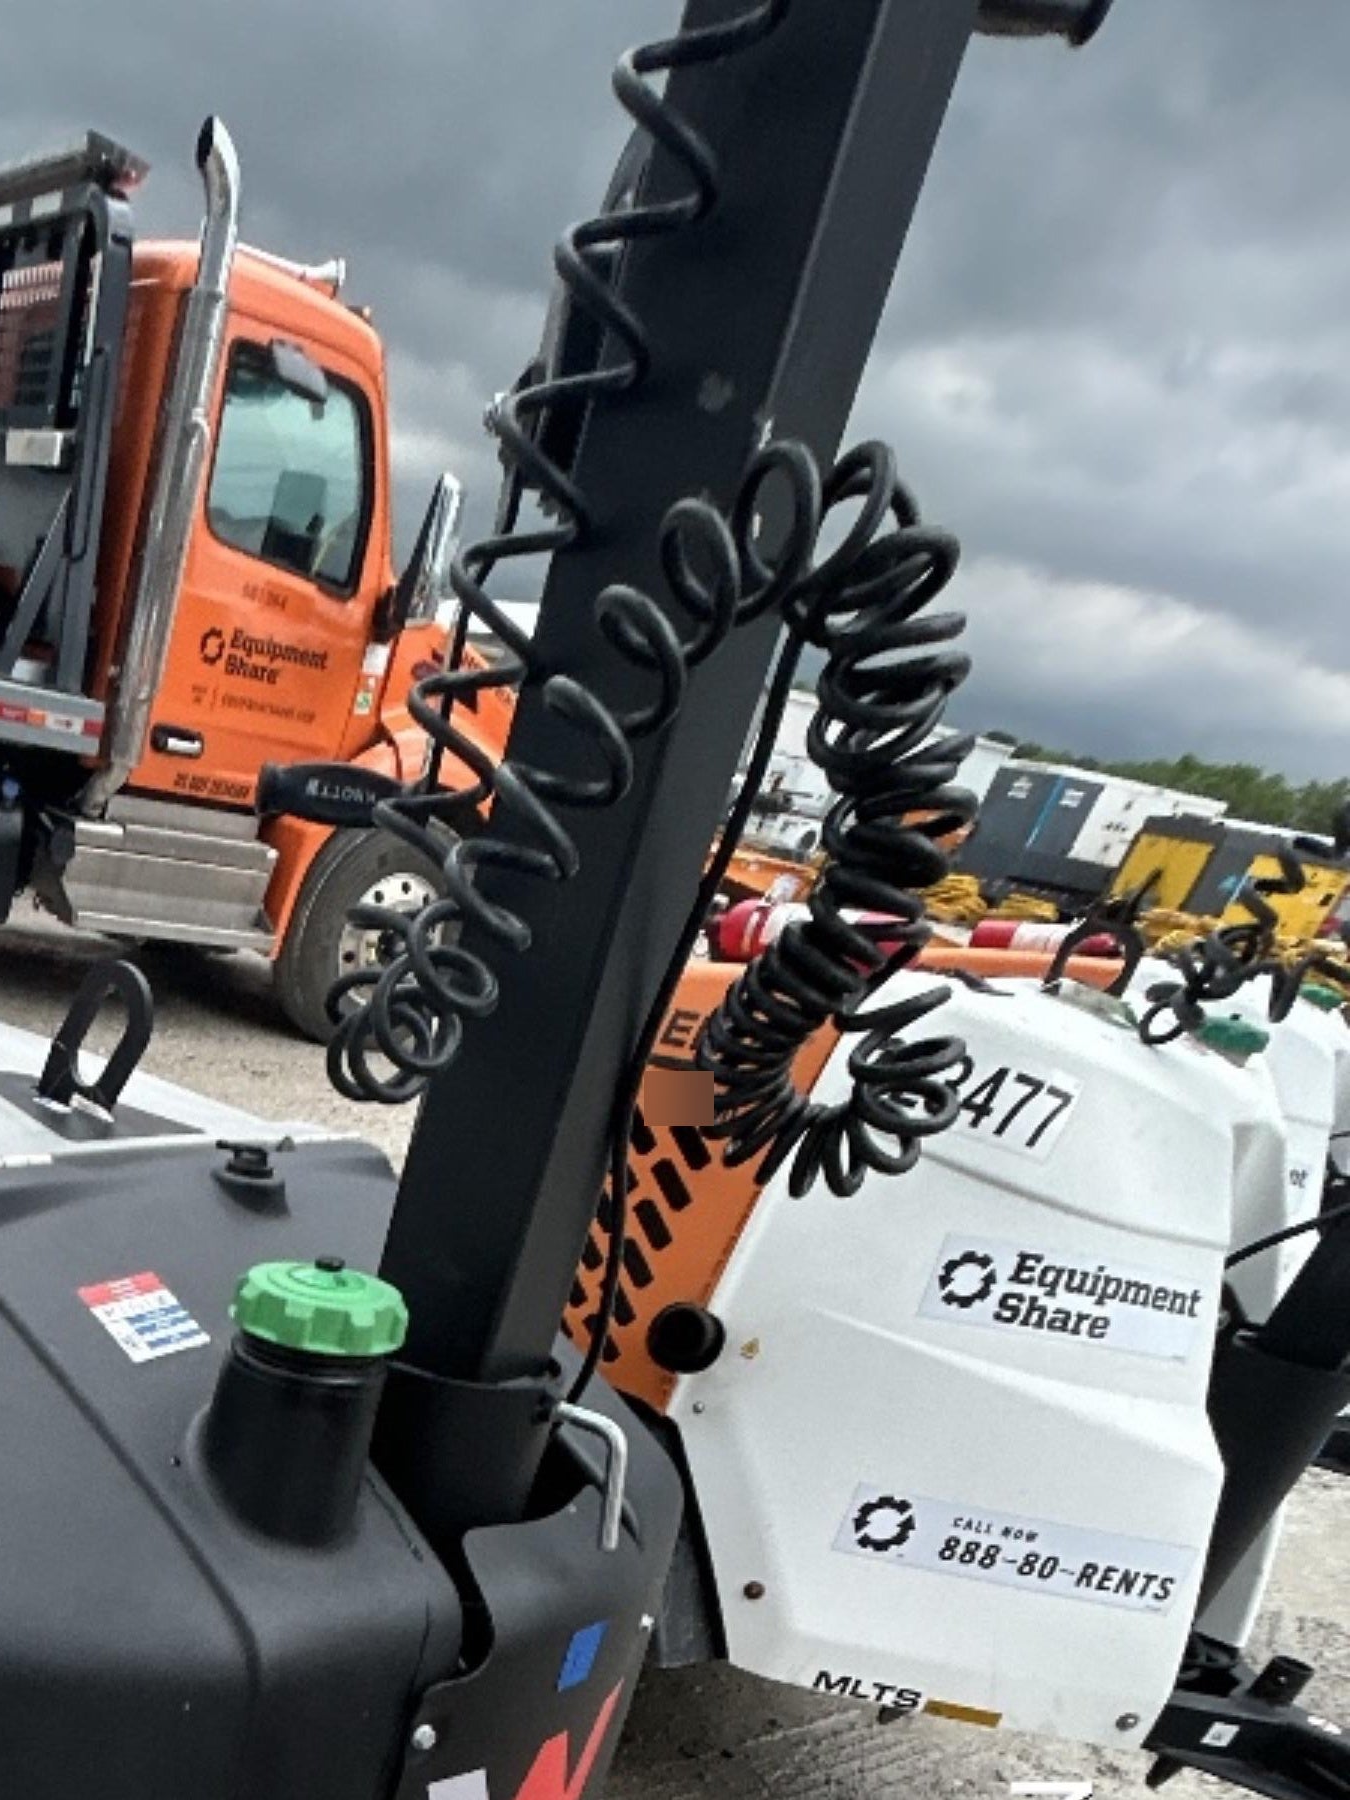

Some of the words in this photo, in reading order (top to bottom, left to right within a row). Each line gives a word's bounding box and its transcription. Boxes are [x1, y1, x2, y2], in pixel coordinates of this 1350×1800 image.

[224, 653, 281, 685] Share
[230, 626, 328, 670] Equipment
[1007, 1250, 1201, 1318] Equipment
[992, 1292, 1112, 1340] Share
[952, 1517, 993, 1535] CALL
[1000, 1525, 1039, 1544] NOW
[937, 1535, 1176, 1602] 888-80-RENTS
[811, 1669, 923, 1710] MLTS
